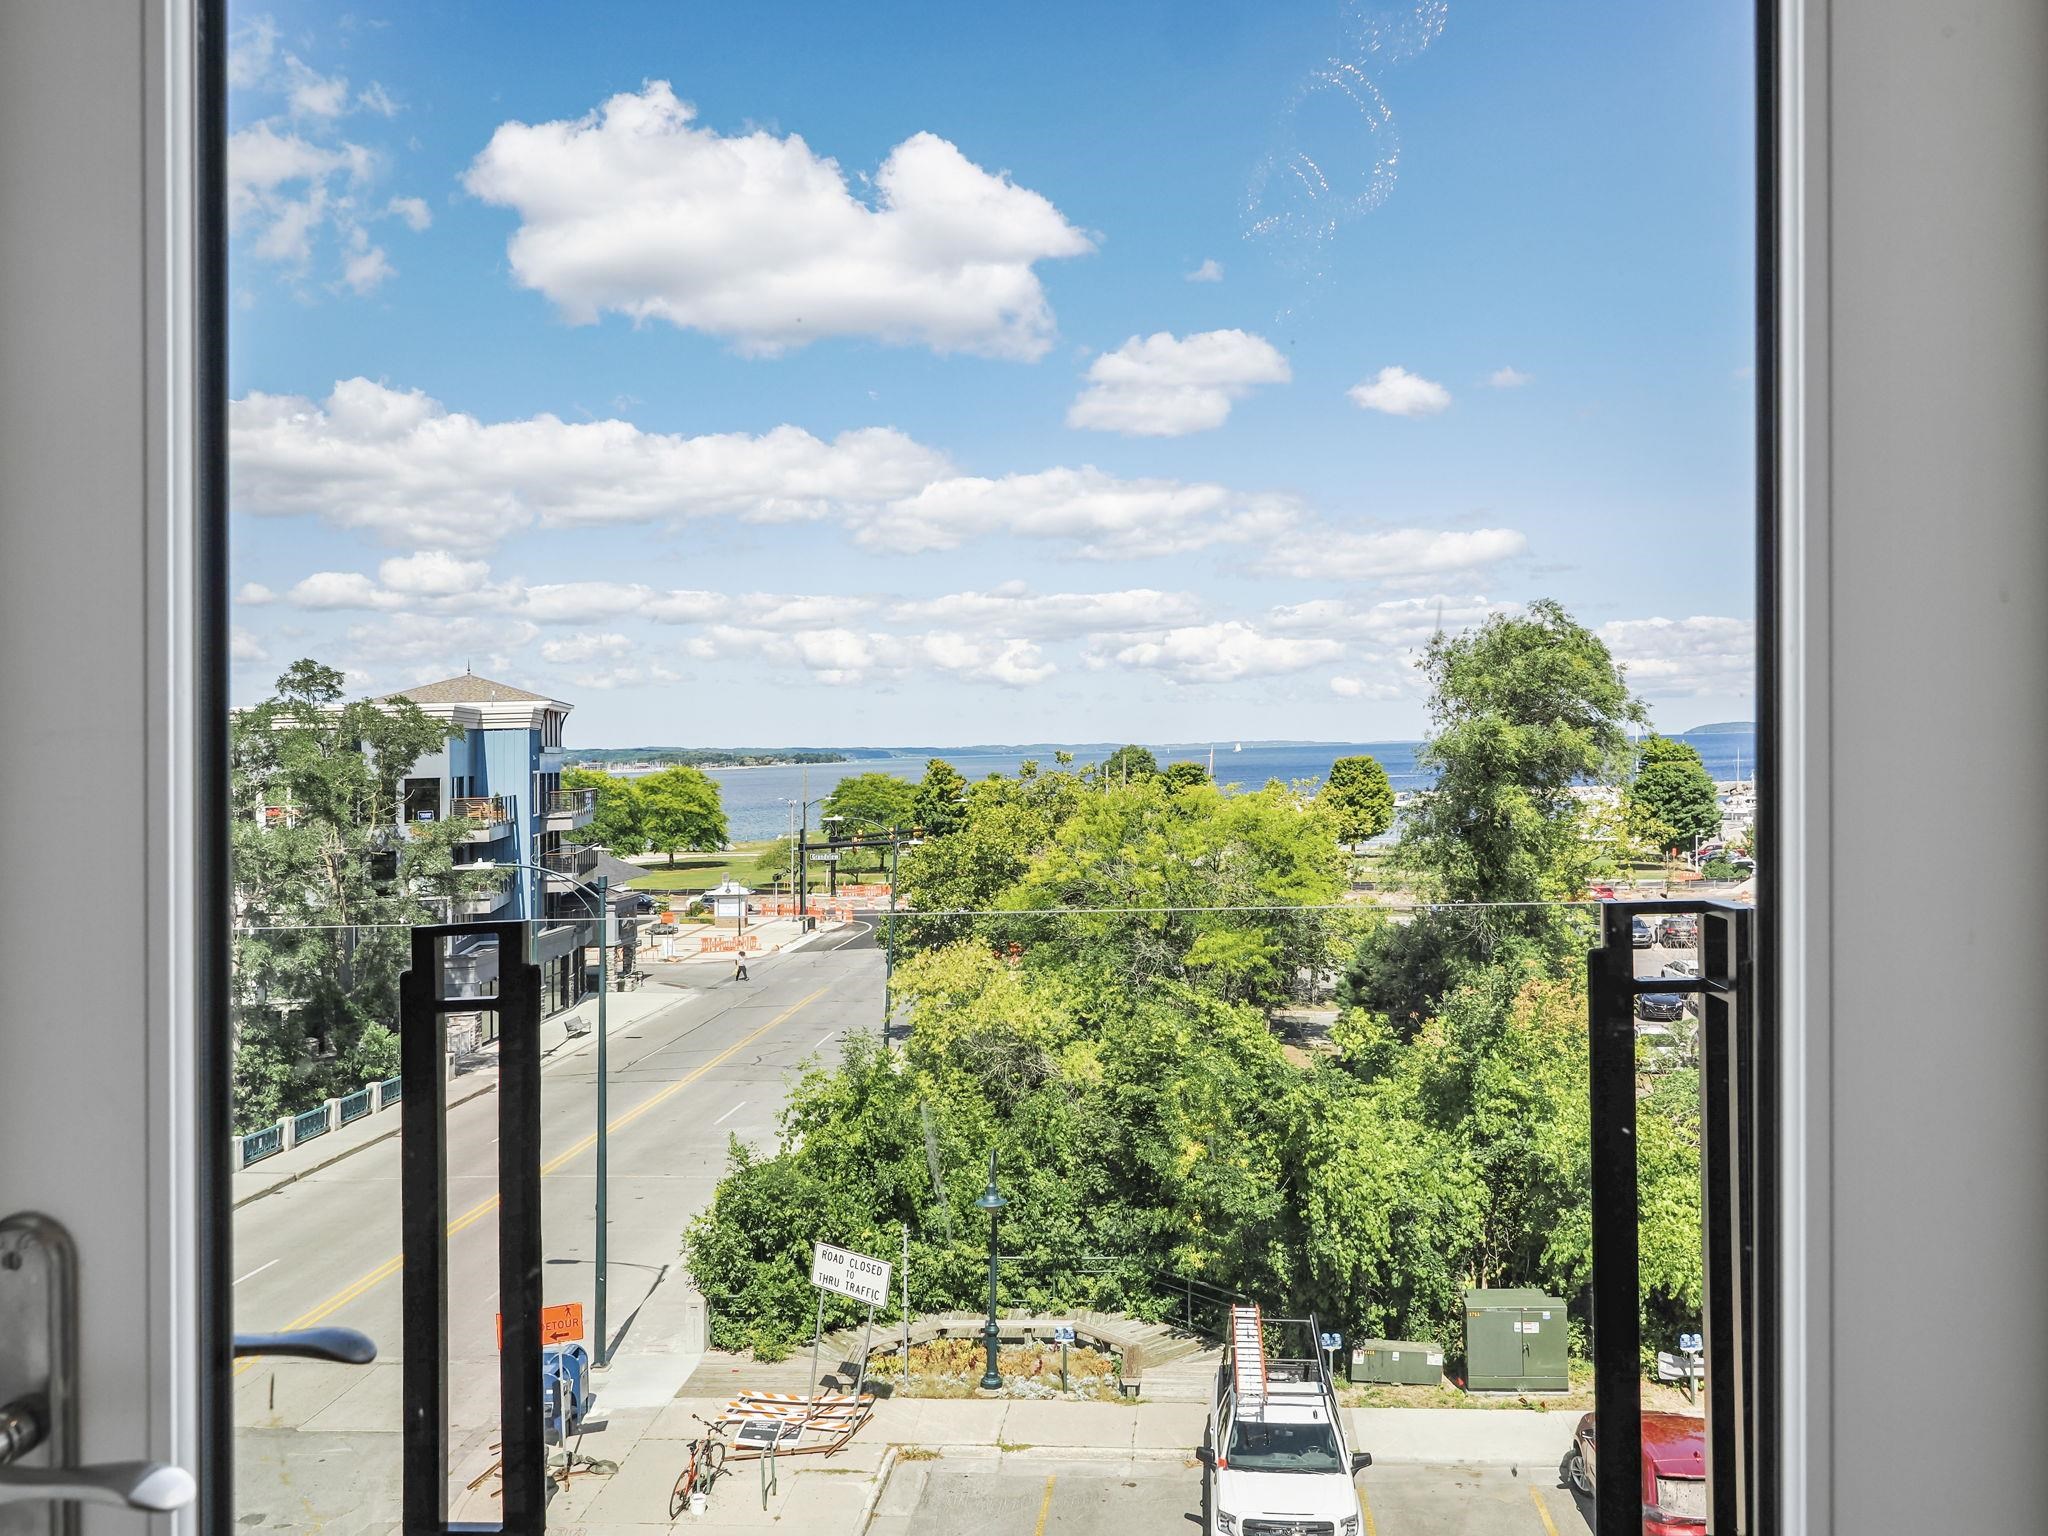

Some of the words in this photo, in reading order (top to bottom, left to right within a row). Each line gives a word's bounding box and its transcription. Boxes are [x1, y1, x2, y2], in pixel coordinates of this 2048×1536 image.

[821, 1250, 844, 1265] ROAD
[849, 1258, 883, 1276] CLOSED
[845, 1269, 855, 1280] TO
[818, 1272, 840, 1288] THRU
[845, 1281, 880, 1301] TRAFFIC
